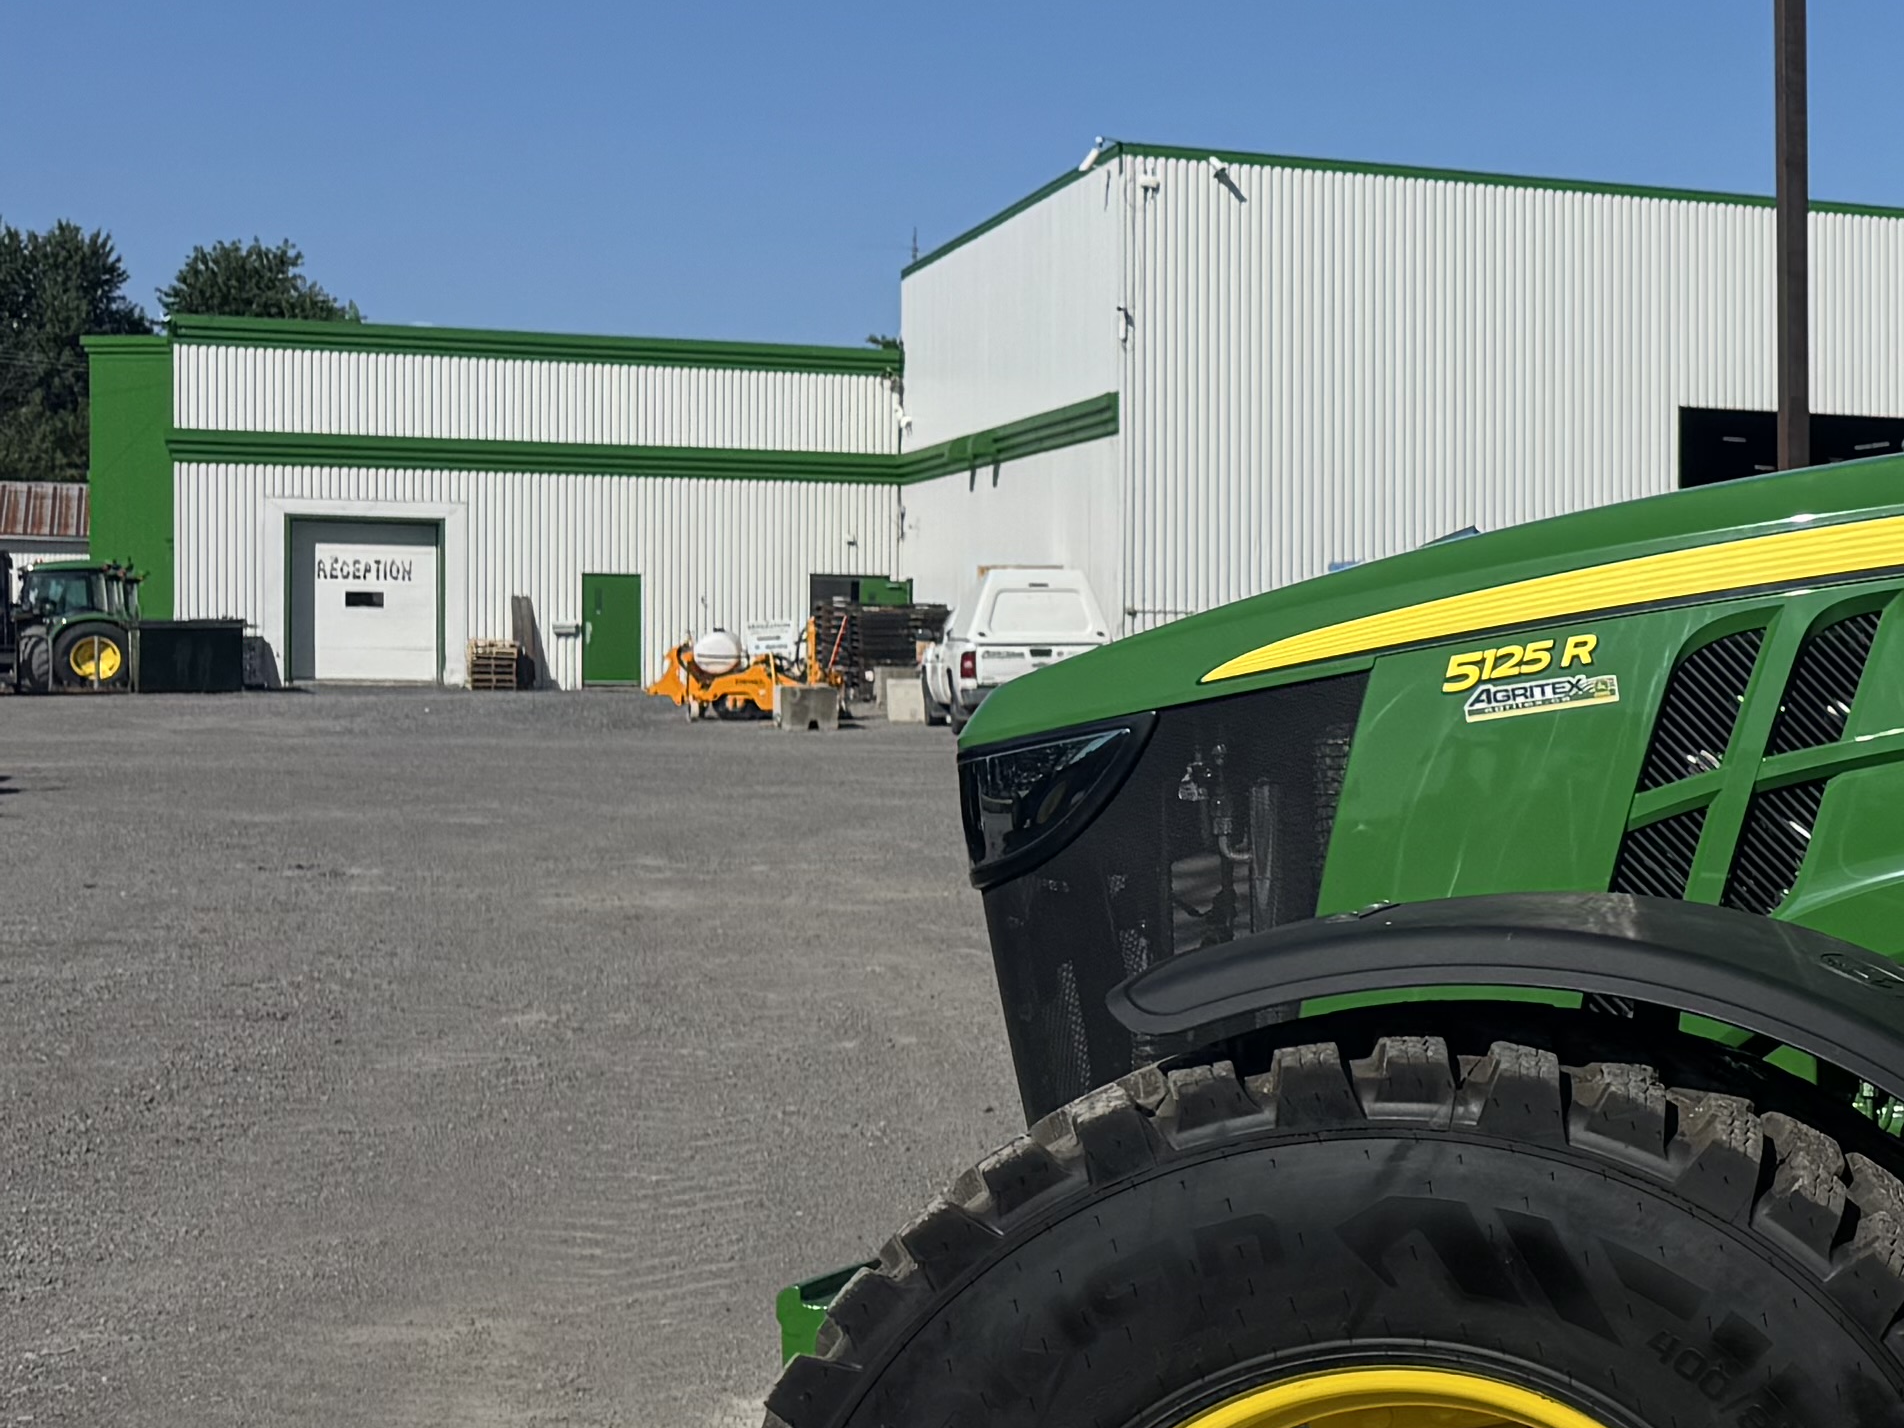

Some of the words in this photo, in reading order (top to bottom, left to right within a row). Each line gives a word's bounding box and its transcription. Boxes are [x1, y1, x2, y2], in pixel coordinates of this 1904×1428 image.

[1442, 639, 1554, 693] 5125
[1560, 634, 1597, 668] R
[1469, 678, 1585, 708] AGRITEX
